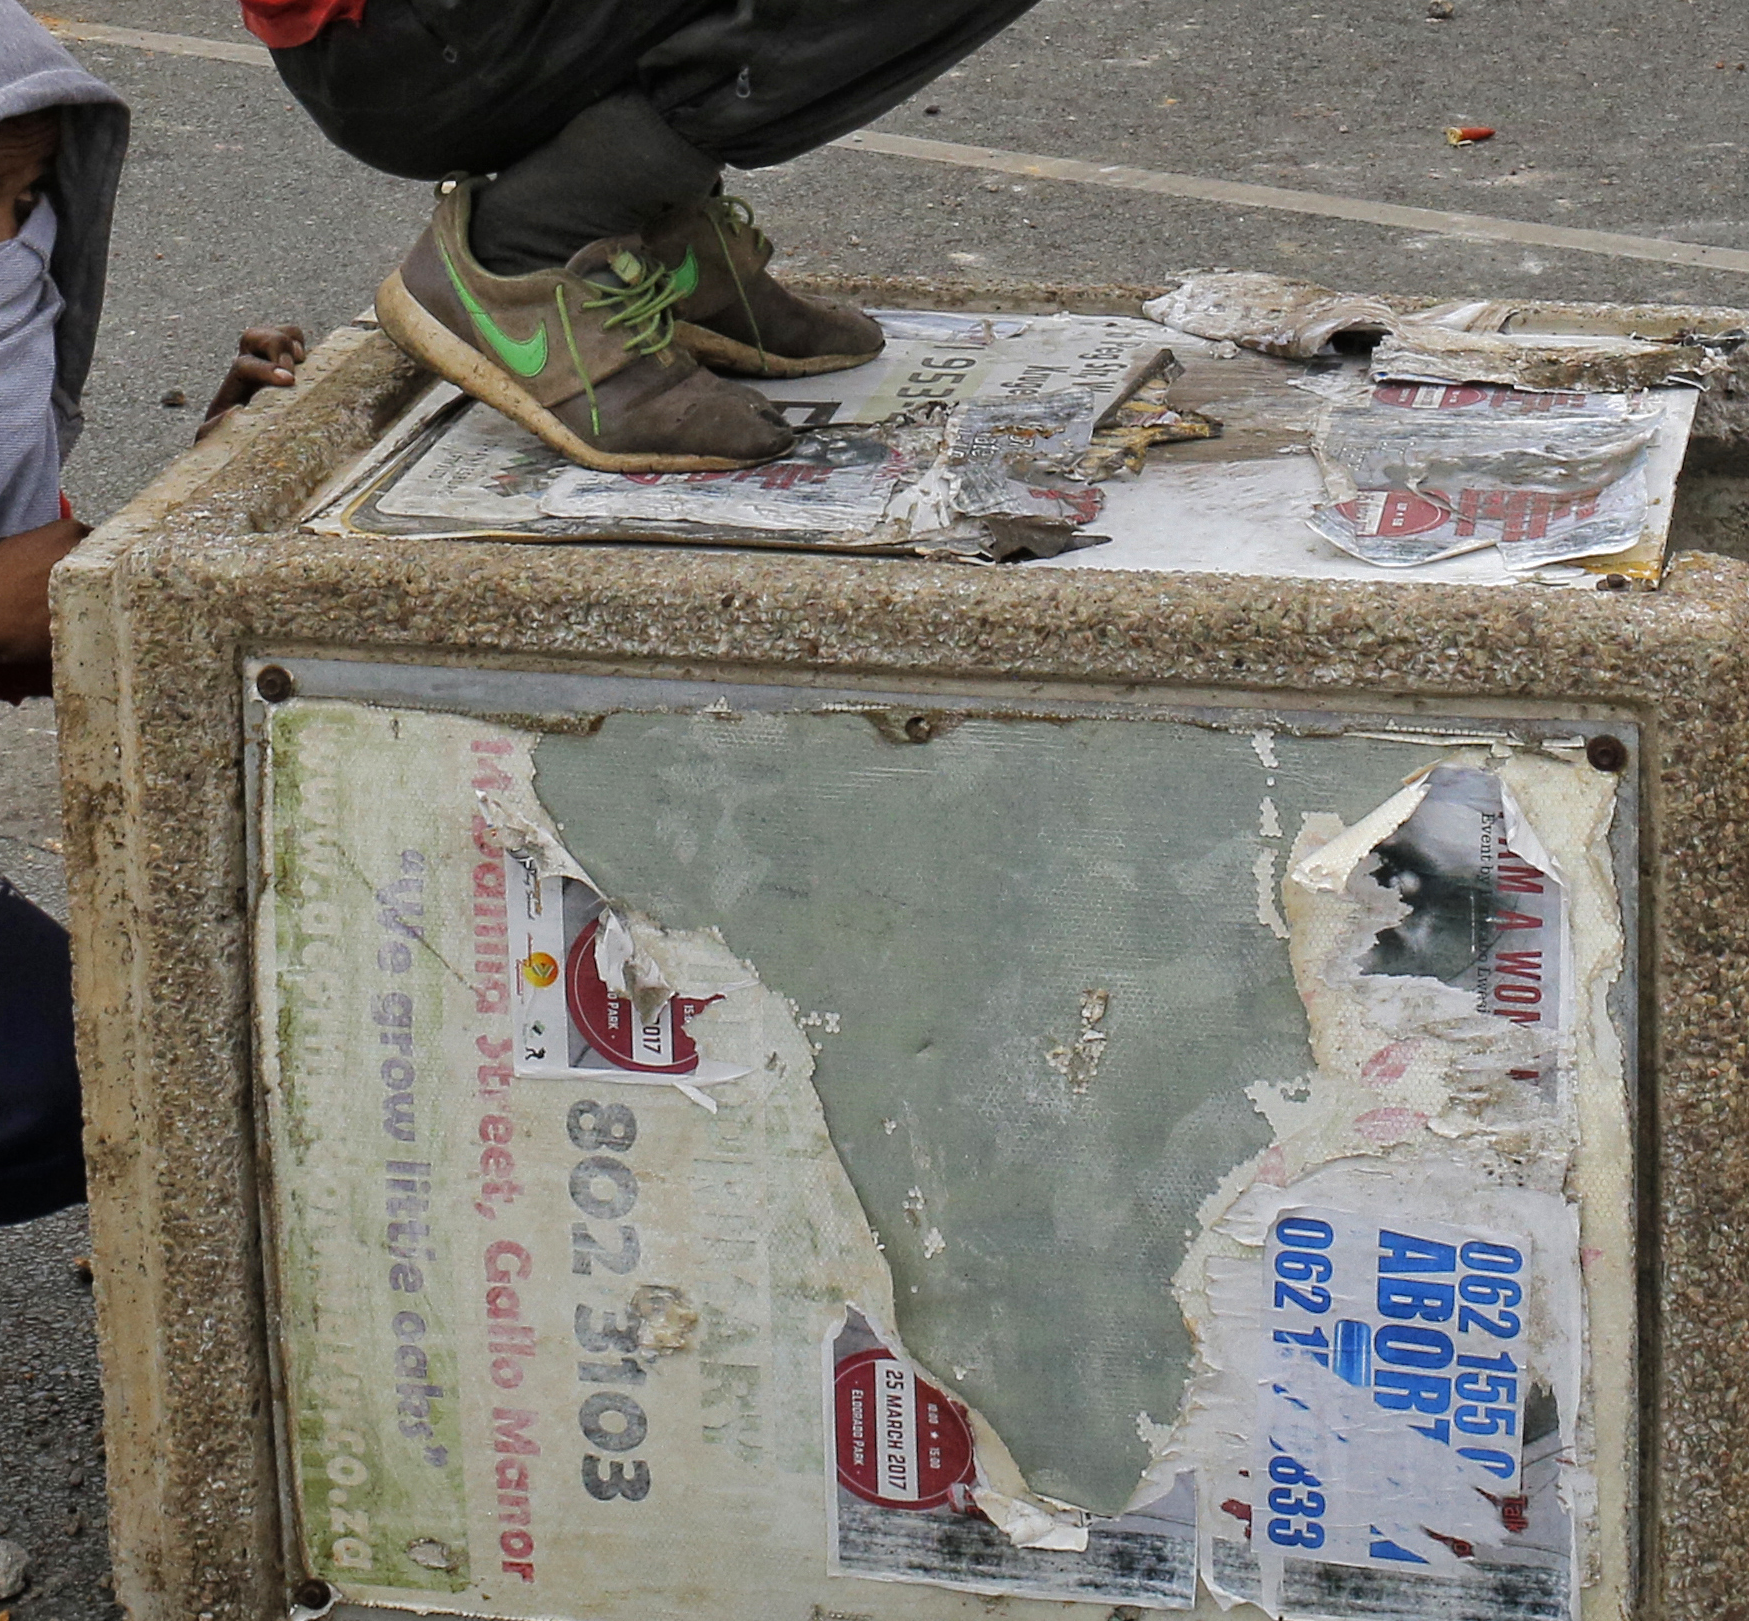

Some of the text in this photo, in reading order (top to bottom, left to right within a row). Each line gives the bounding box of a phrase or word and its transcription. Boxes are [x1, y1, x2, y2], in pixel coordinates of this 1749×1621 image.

[1476, 865, 1494, 884] by
[1479, 812, 1496, 861] Event
[1494, 910, 1544, 932] A
[374, 993, 416, 1143] grow
[384, 1160, 433, 1294] little
[1273, 1216, 1334, 1314] 062
[483, 1240, 534, 1390] Gallo
[566, 1099, 652, 1502] 802 3103
[1457, 1240, 1523, 1340] 062
[885, 1369, 908, 1492] 25 MARCH 2017
[1454, 1351, 1518, 1436] 155
[489, 1406, 536, 1583] Manor
[928, 1446, 941, 1469] 15:00
[1267, 1437, 1326, 1551] 833
